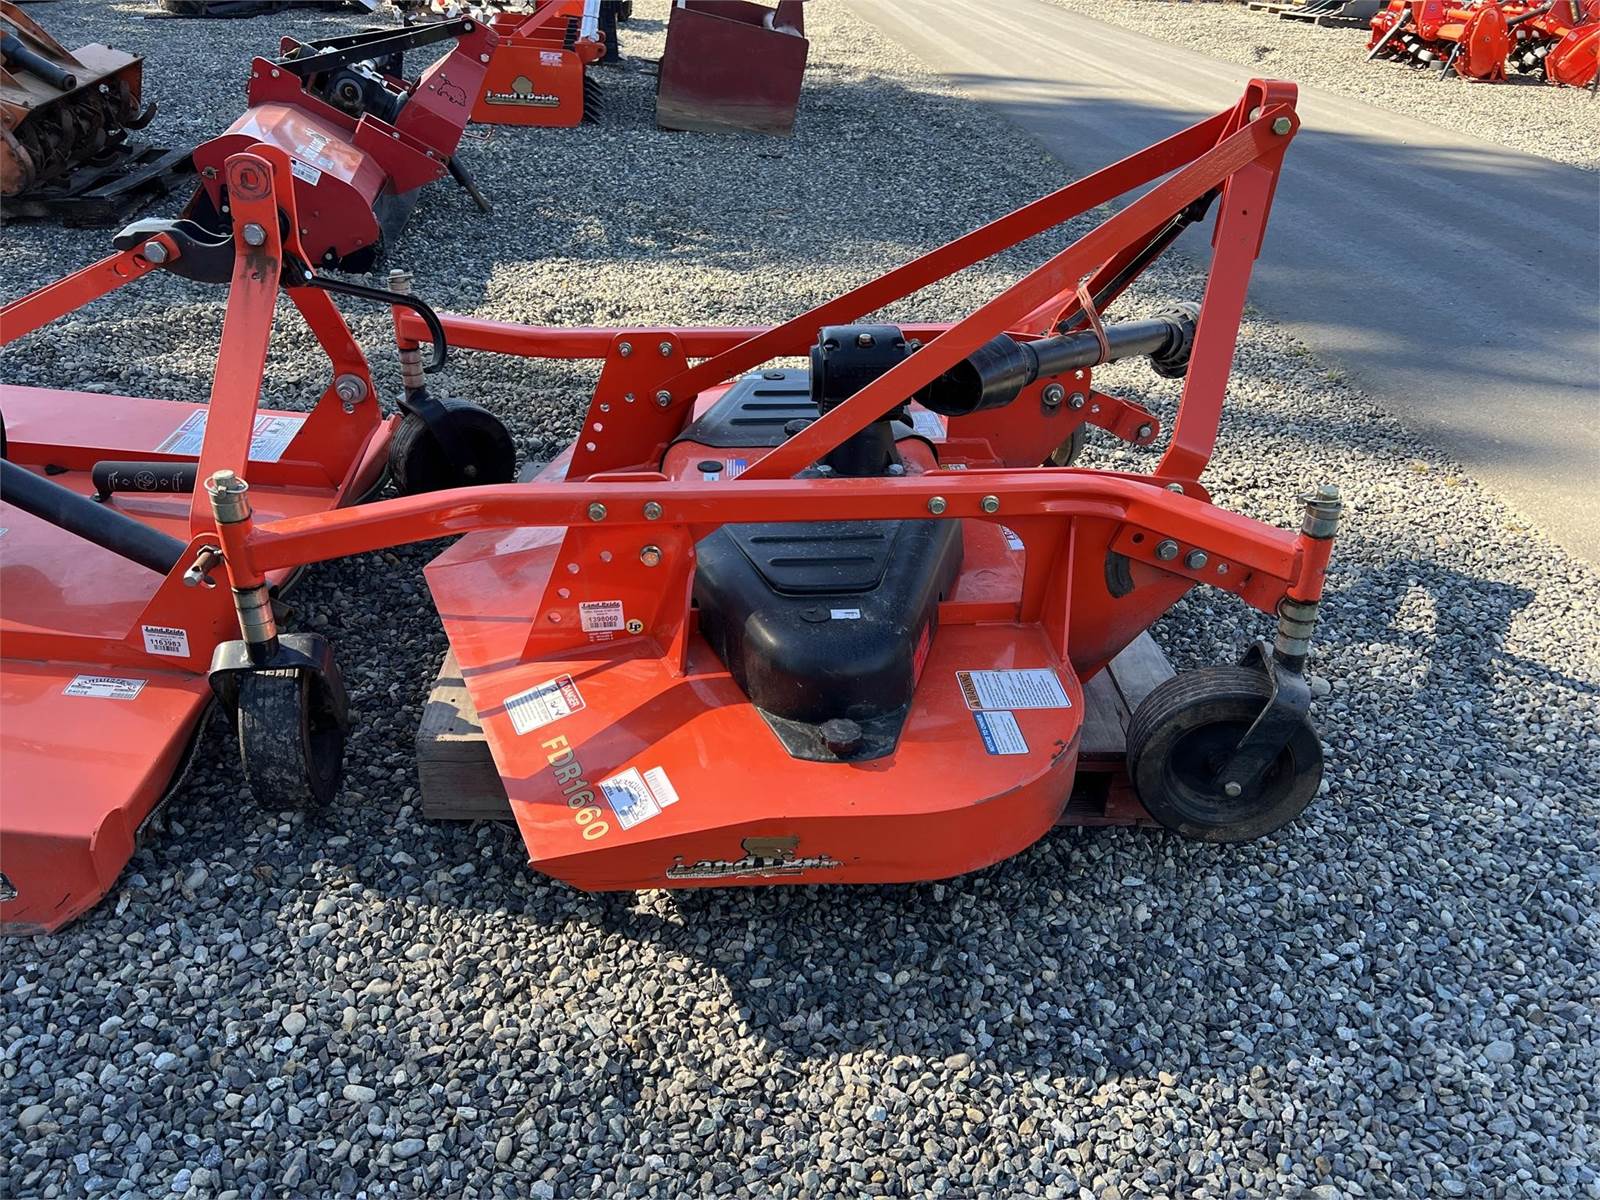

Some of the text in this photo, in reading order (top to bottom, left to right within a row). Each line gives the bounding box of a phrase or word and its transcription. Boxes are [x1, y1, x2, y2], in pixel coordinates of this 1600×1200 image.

[486, 90, 559, 104] Land Pride
[165, 628, 185, 637] Pride
[561, 684, 580, 708] DANGER
[541, 734, 610, 841] FDR1660
